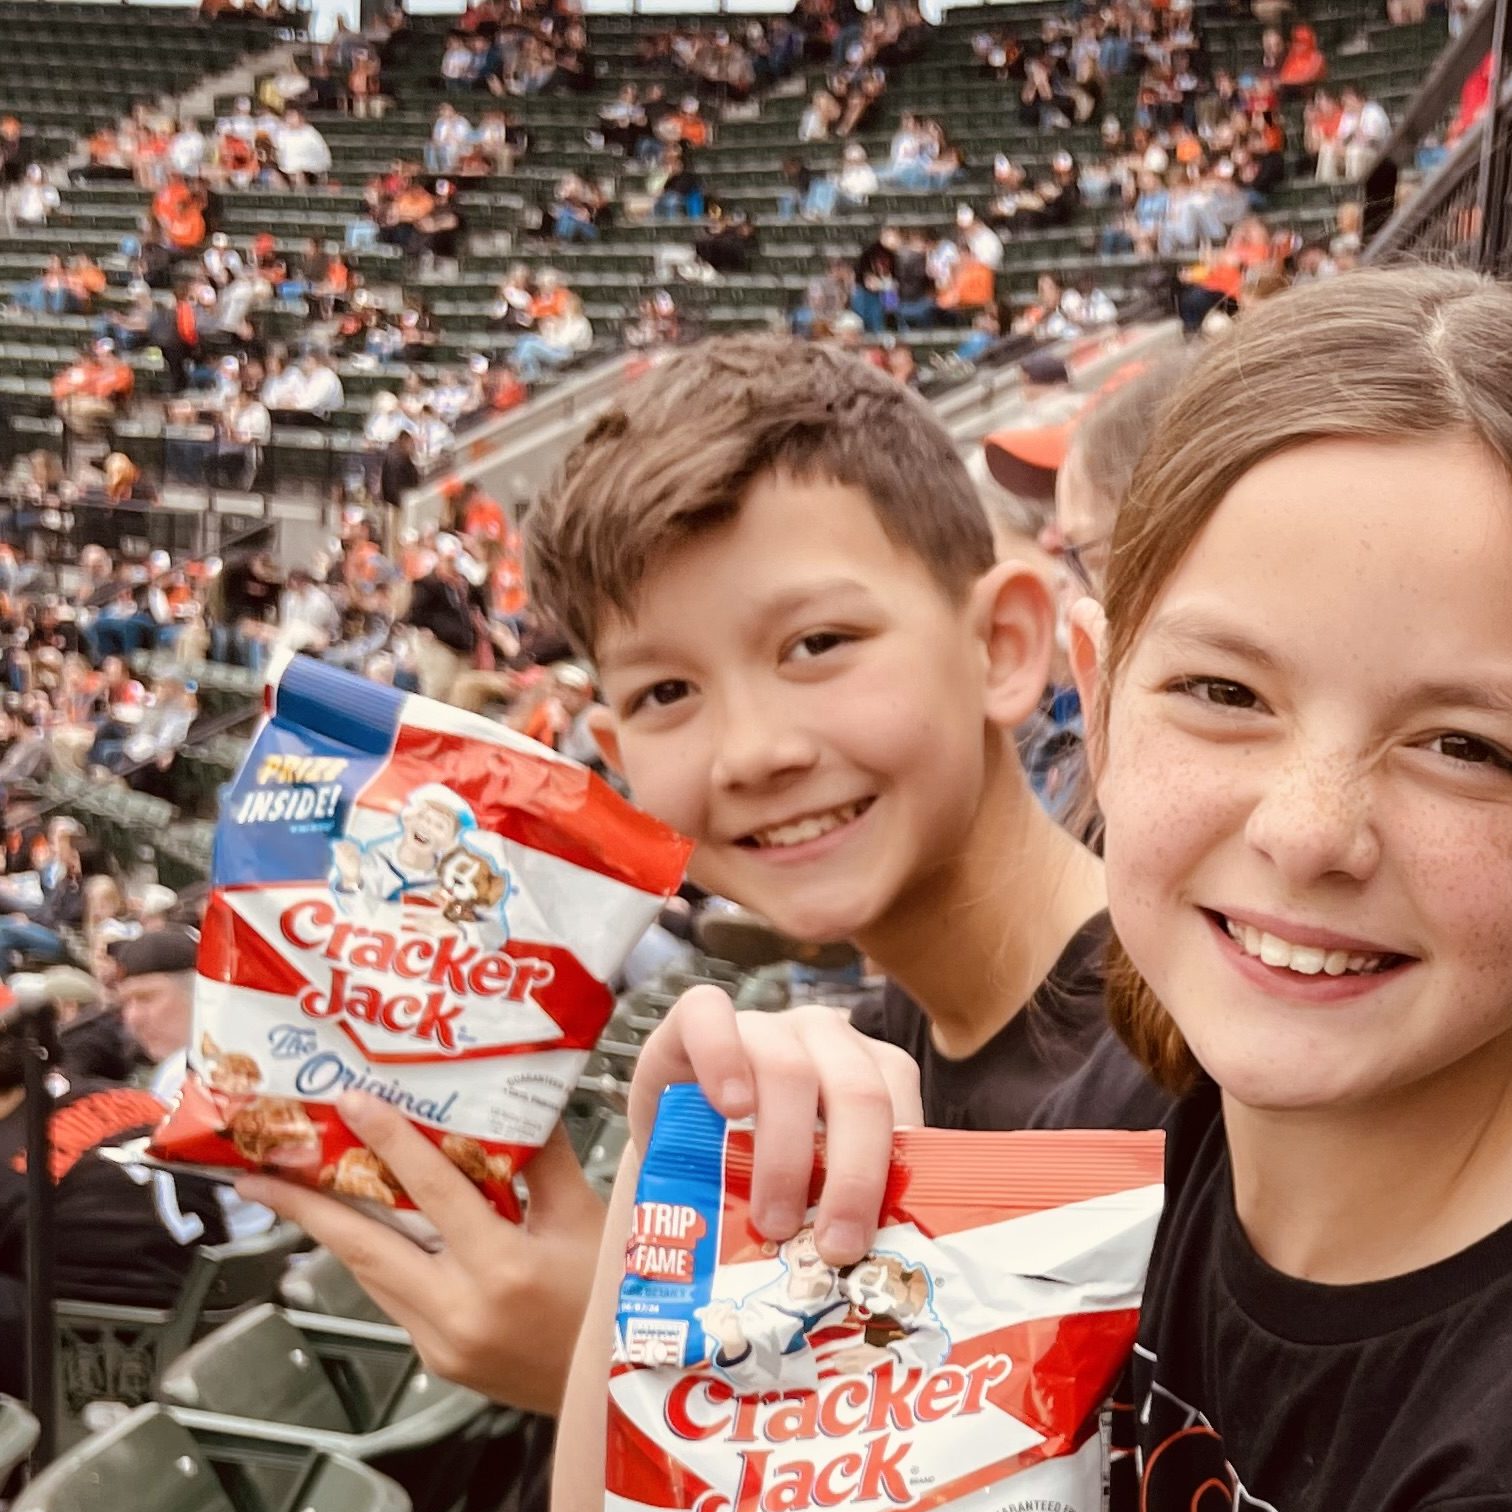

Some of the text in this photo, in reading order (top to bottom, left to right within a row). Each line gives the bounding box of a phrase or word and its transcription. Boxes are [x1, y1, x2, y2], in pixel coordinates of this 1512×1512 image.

[257, 754, 349, 785] PRIZE
[238, 784, 342, 824] INSIDE!
[280, 900, 554, 1002] Cracker
[300, 967, 464, 1048] Jack
[268, 1024, 317, 1058] The
[641, 1202, 698, 1239] TRIP
[636, 1245, 687, 1276] FAME
[664, 1356, 1010, 1443] Cracker
